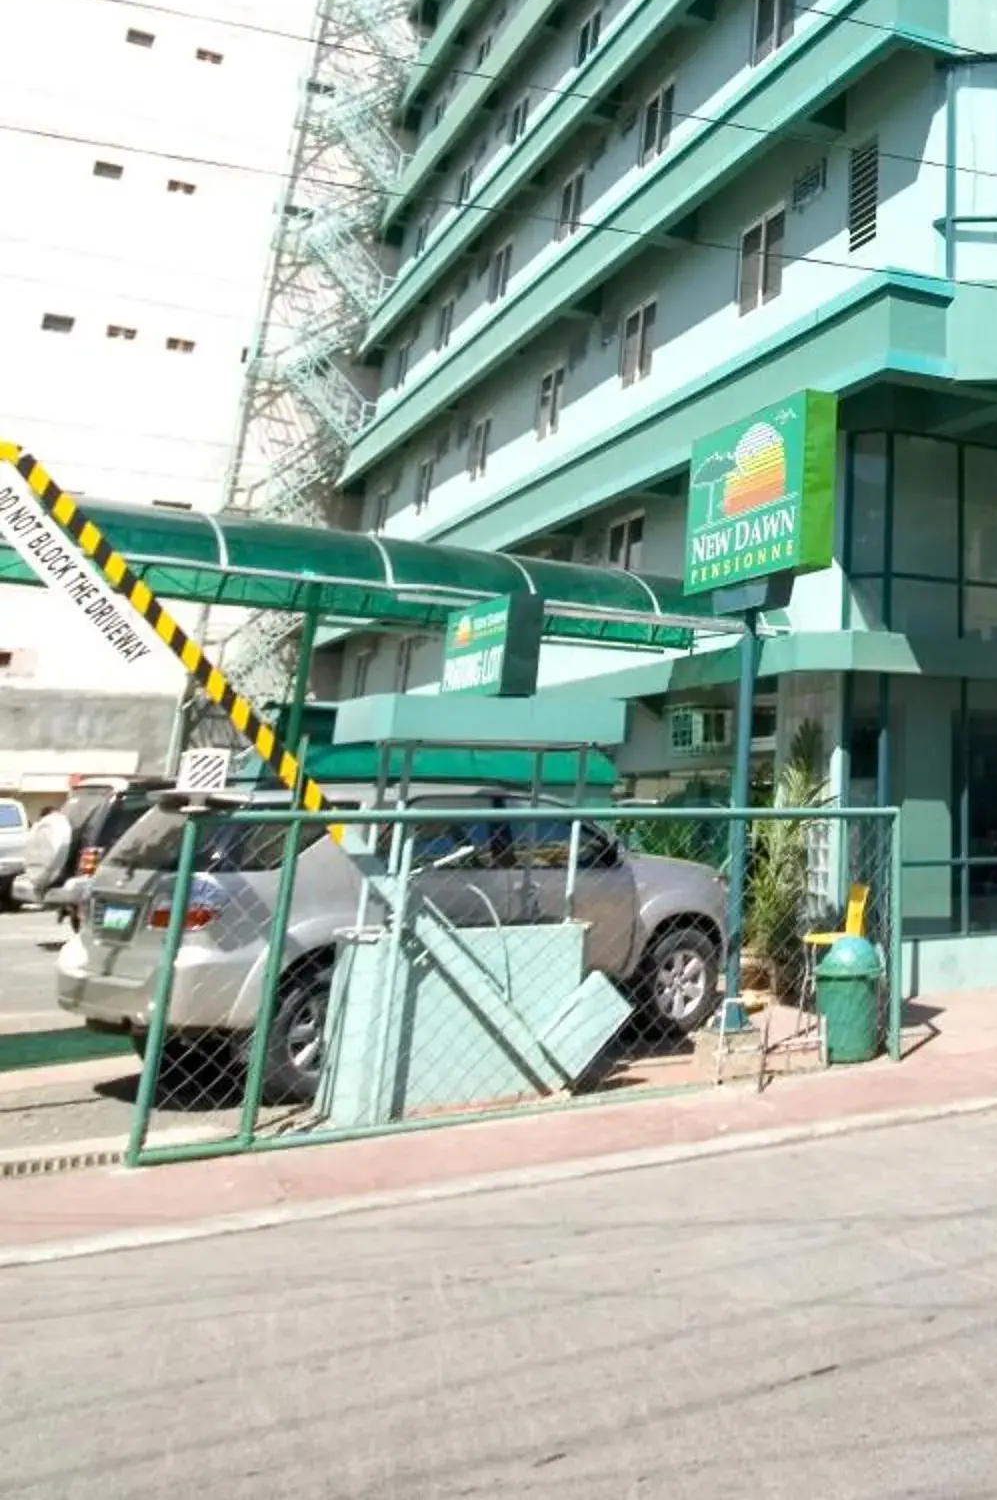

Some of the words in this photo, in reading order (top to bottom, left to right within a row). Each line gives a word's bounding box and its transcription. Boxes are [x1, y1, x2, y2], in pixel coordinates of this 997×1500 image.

[0, 486, 20, 511] DO
[4, 505, 43, 539] NOT
[692, 528, 733, 565] NEW
[735, 506, 796, 551] DAWN
[28, 531, 77, 580] BLOCK
[691, 540, 794, 585] PENSIONNE
[64, 571, 100, 605] THE
[84, 597, 151, 664] DRIVEWAY
